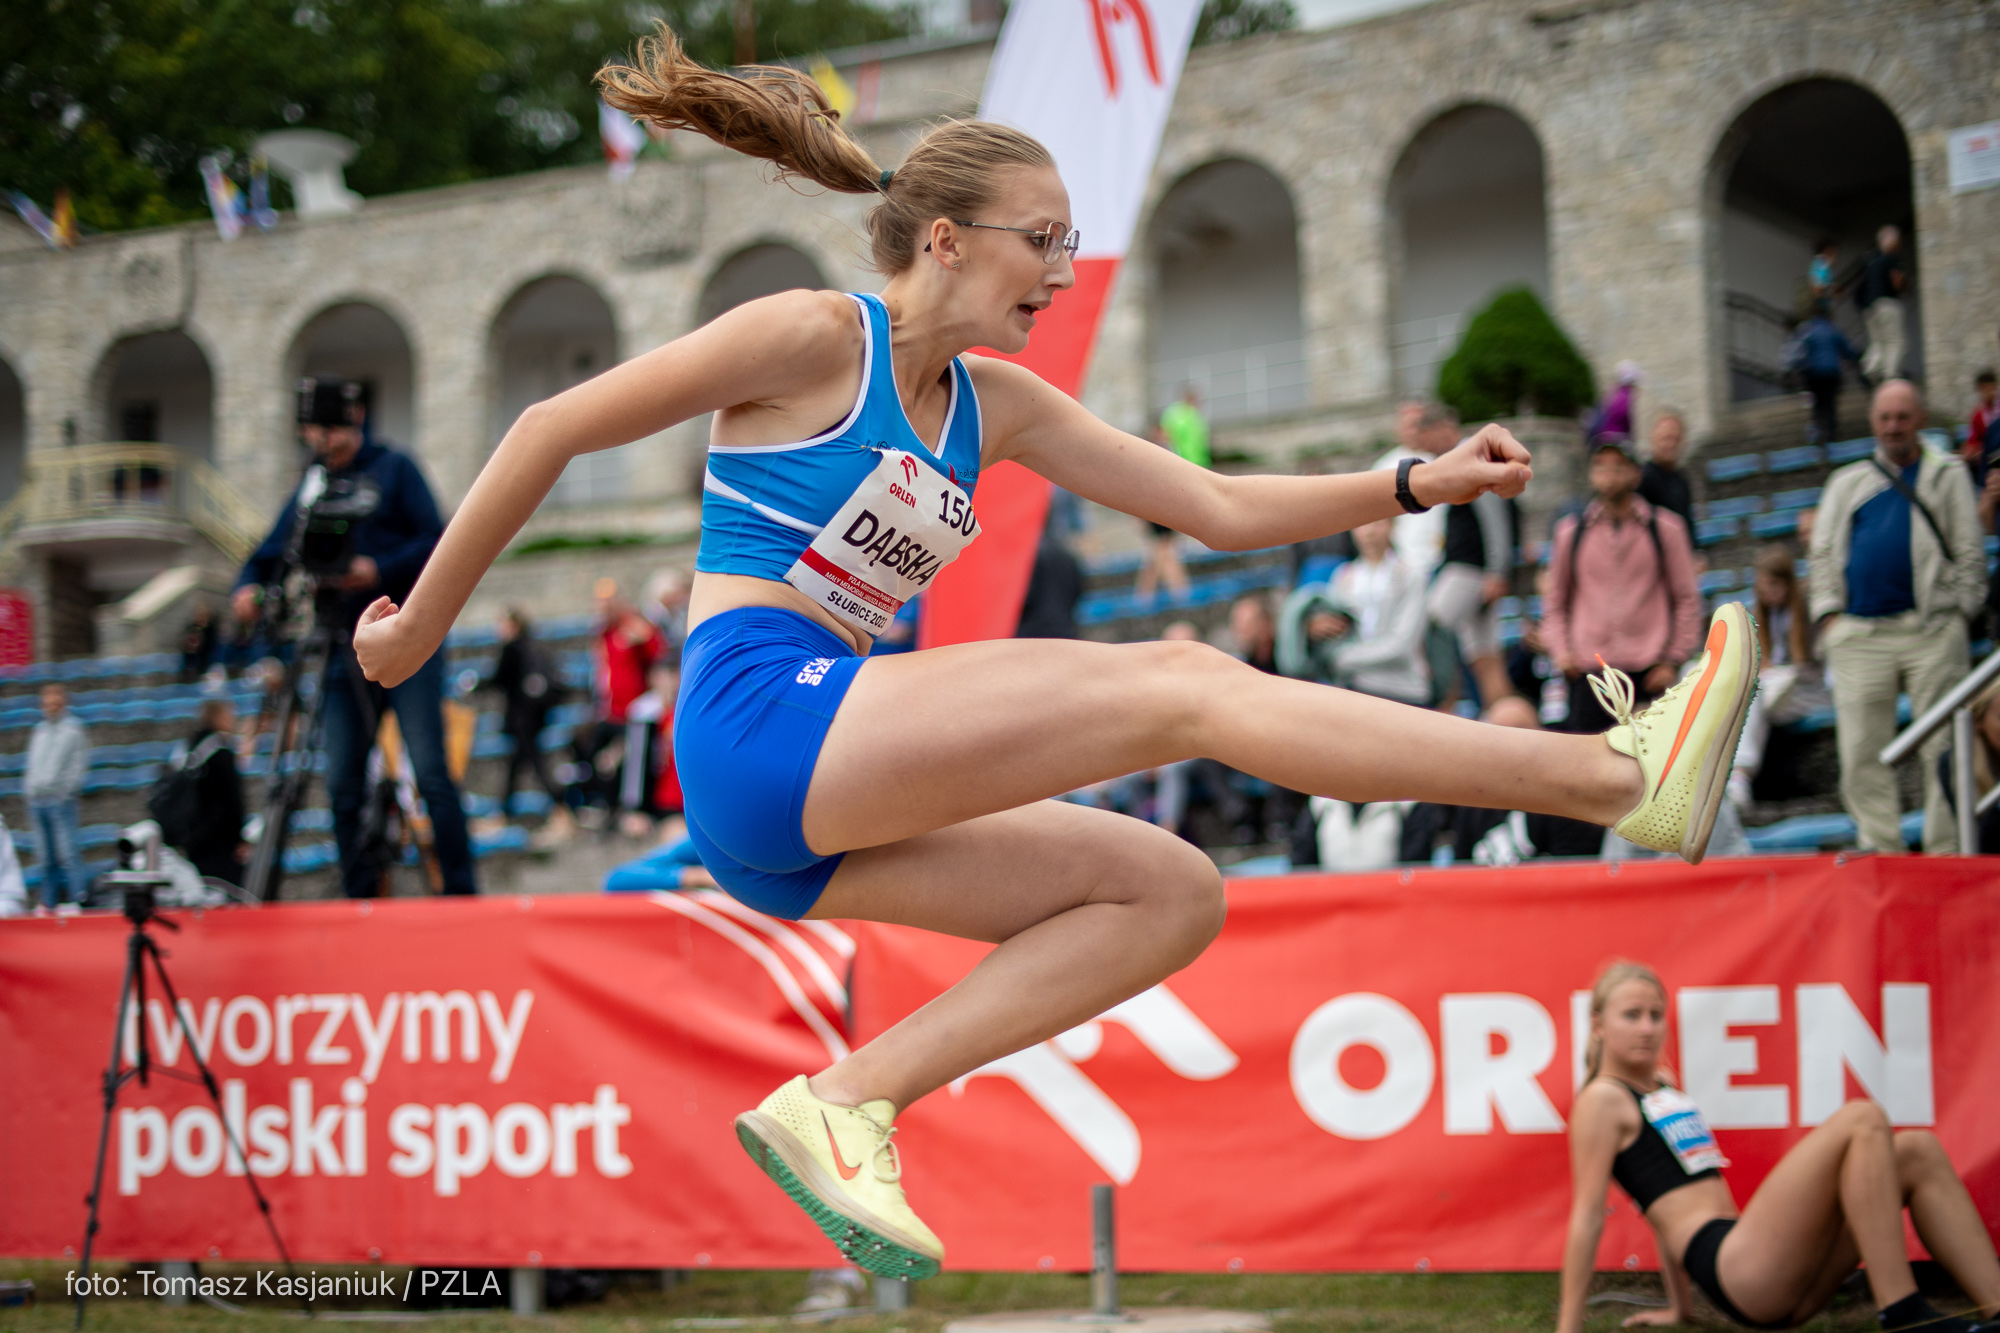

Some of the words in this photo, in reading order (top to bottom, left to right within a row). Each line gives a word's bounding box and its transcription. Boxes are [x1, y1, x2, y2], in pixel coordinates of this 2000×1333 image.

[889, 482, 917, 508] ORLEN
[938, 489, 976, 537] 150
[841, 508, 944, 587] DĄBSKA
[824, 571, 842, 584] MAŁY
[847, 575, 861, 588] PZLA
[827, 590, 872, 622] SŁUBICE
[1290, 983, 1935, 1140] OREN
[117, 1077, 368, 1197] polski
[388, 1083, 634, 1198] sport
